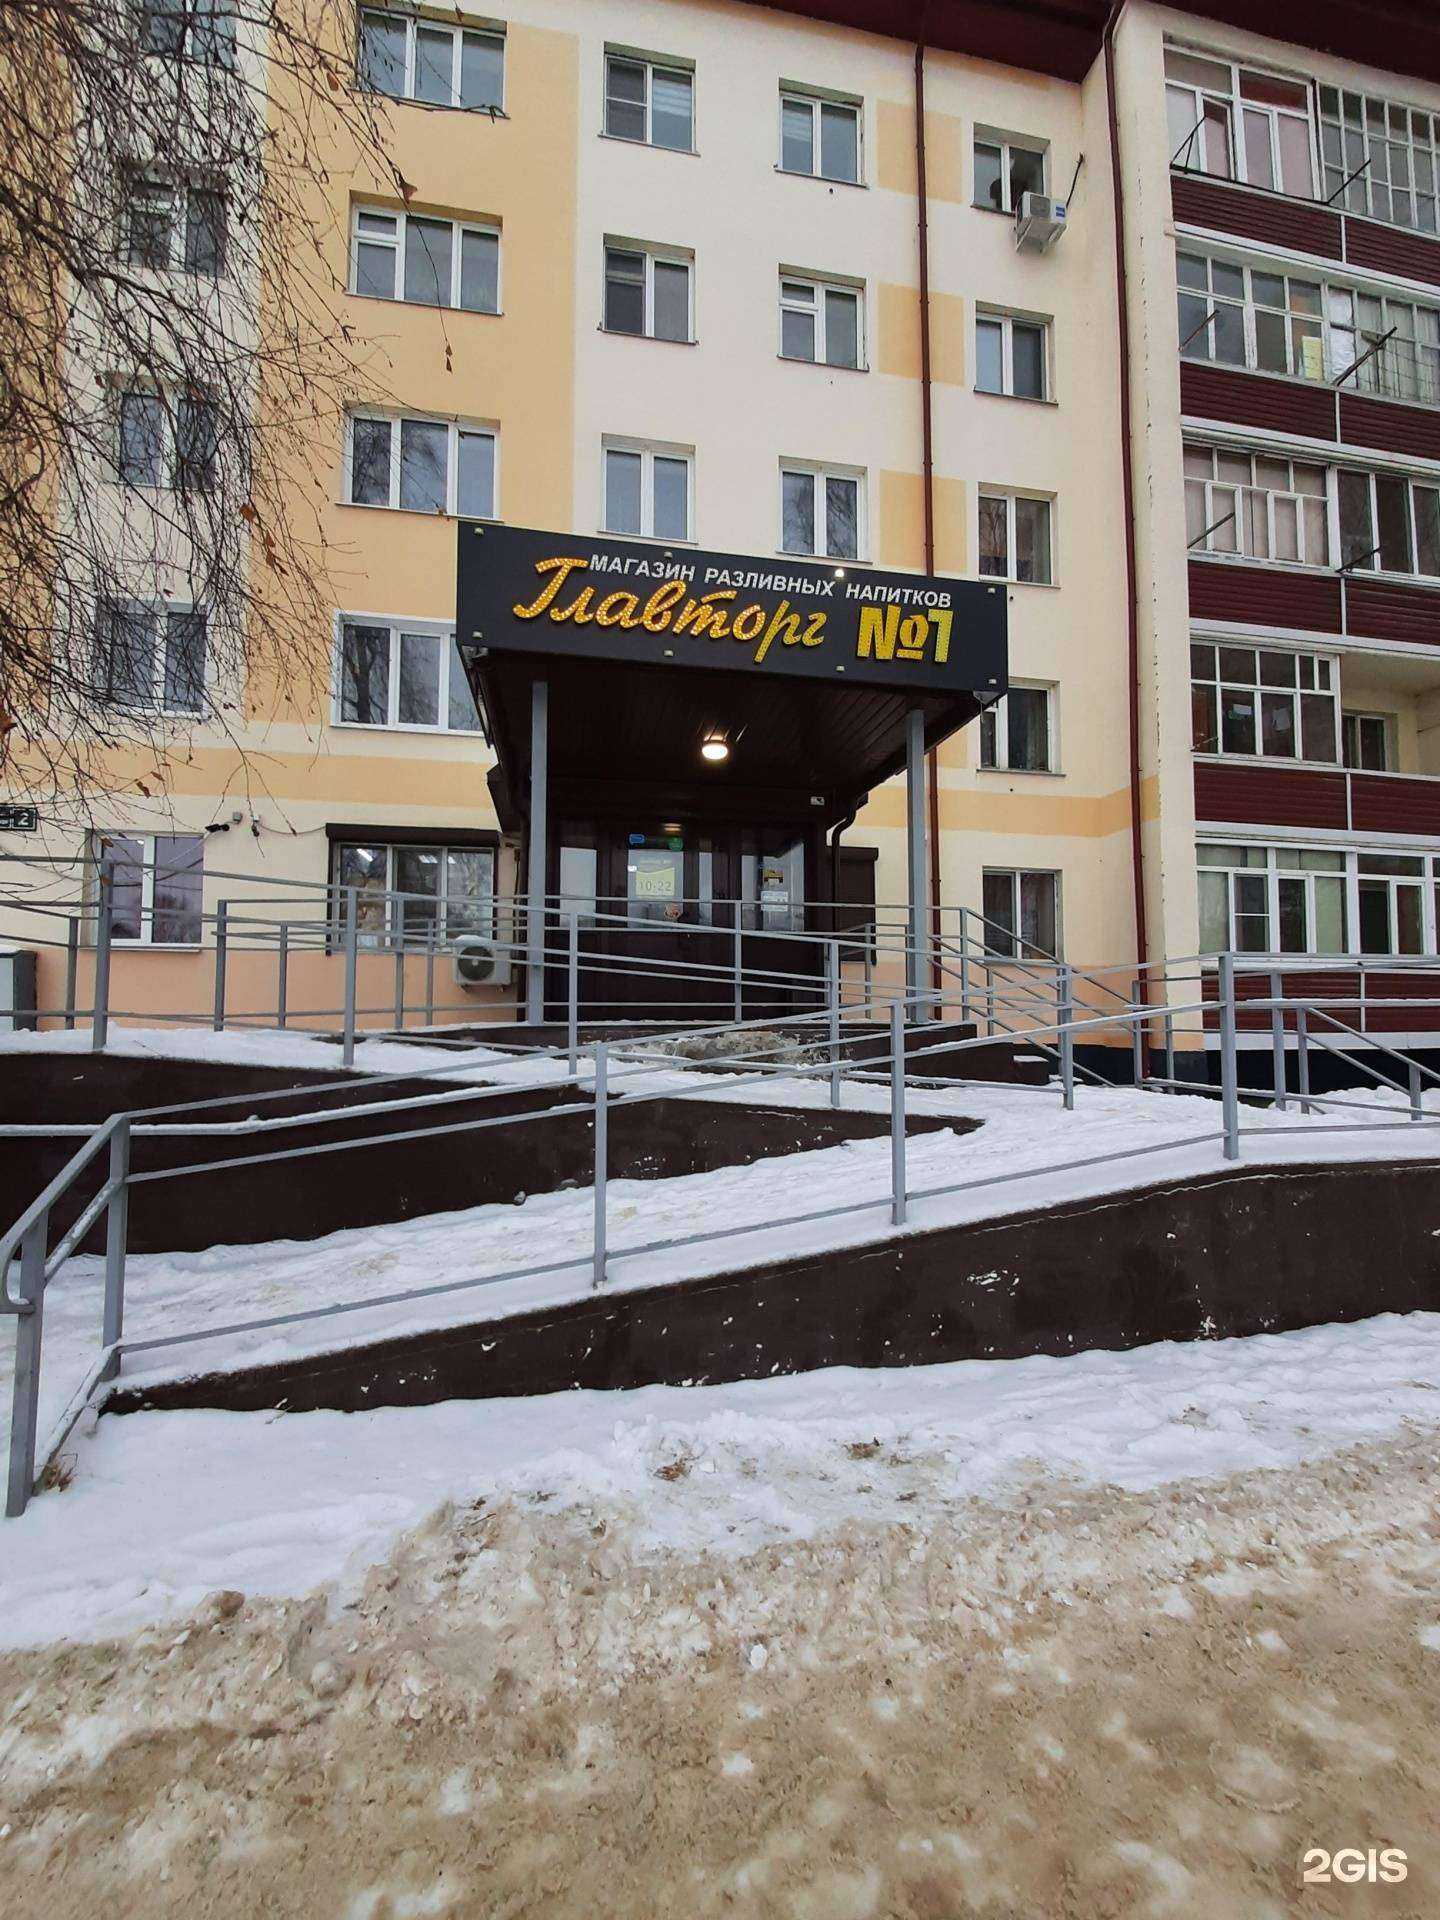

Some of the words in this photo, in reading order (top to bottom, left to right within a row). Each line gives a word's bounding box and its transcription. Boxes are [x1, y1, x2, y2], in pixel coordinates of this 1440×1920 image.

[590, 554, 696, 582] МАГАЗИН
[704, 567, 836, 597] РАЗЛИВНЫХ
[846, 583, 951, 608] НАПИТКОВ
[512, 557, 827, 664] Главторг
[18, 812, 29, 826] 2
